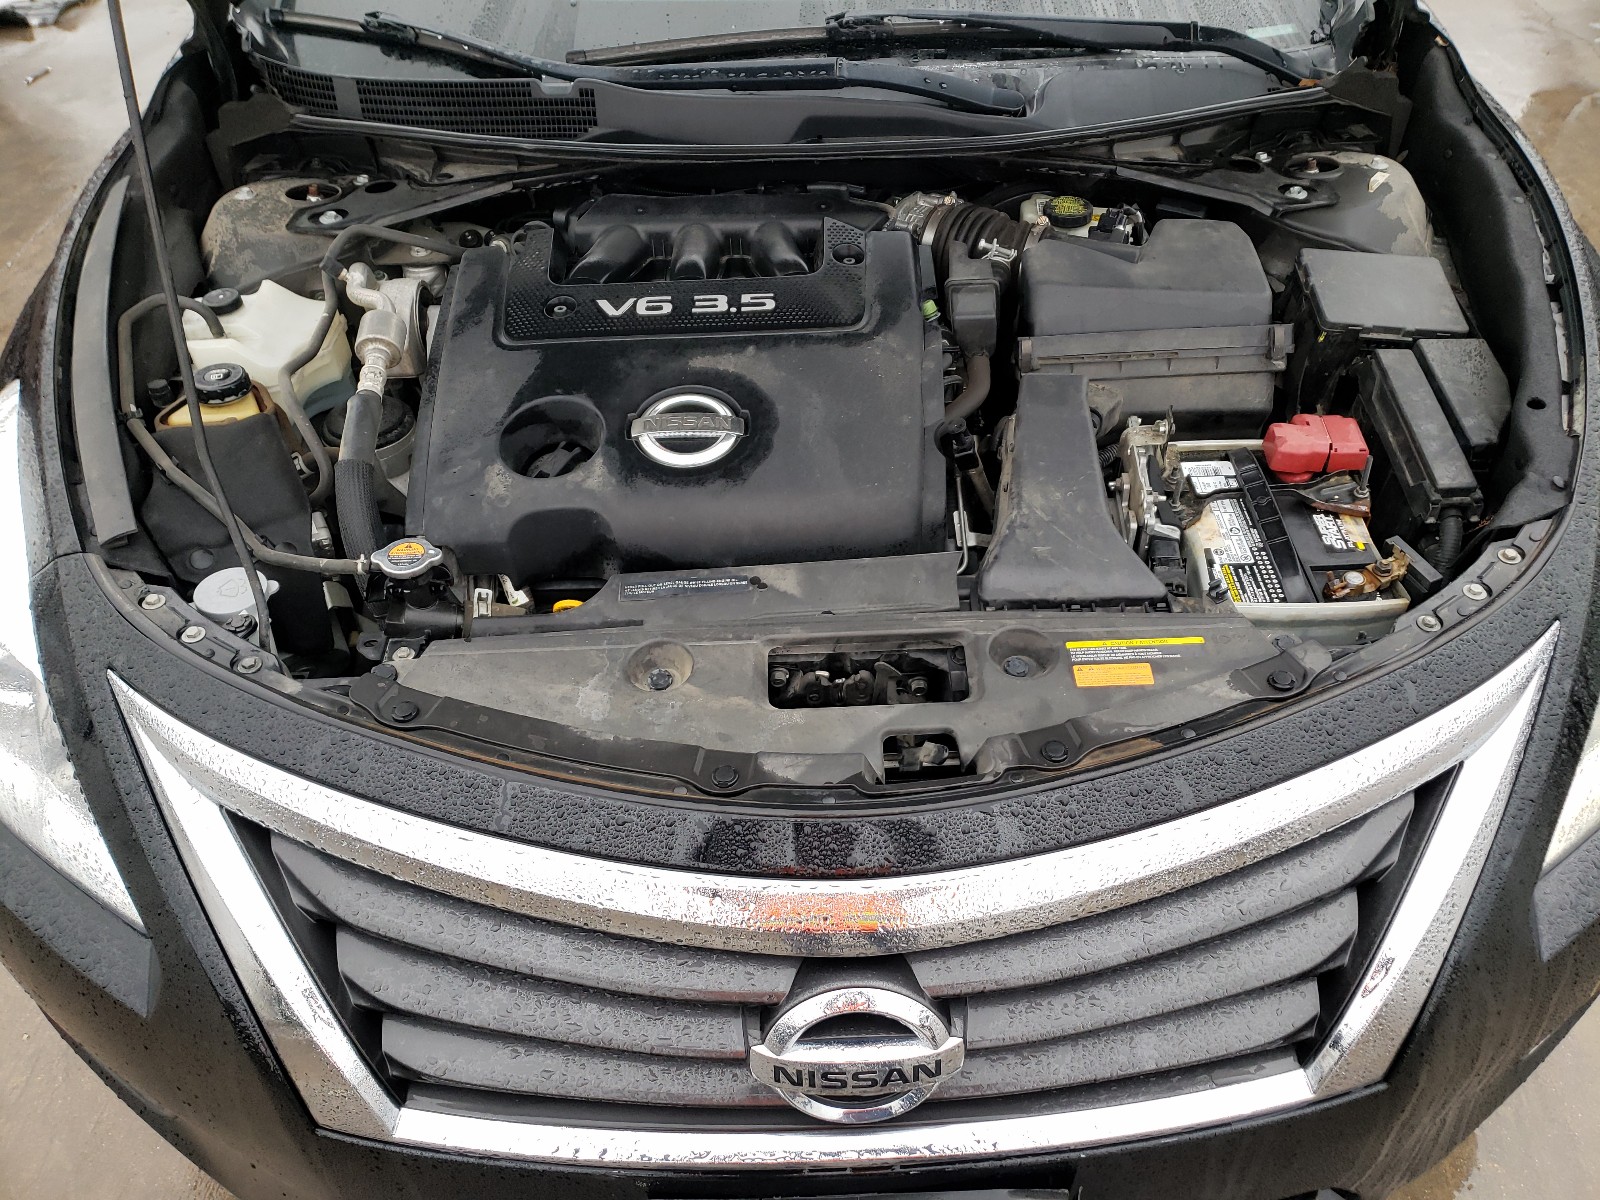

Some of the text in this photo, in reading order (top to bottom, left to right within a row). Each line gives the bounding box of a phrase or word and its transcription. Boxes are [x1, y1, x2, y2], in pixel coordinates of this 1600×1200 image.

[596, 293, 776, 317] V6 3.5
[643, 414, 733, 431] NISSAN
[1313, 513, 1332, 546] SUPER
[1324, 514, 1348, 550] START
[773, 1058, 942, 1089] NISSAN
